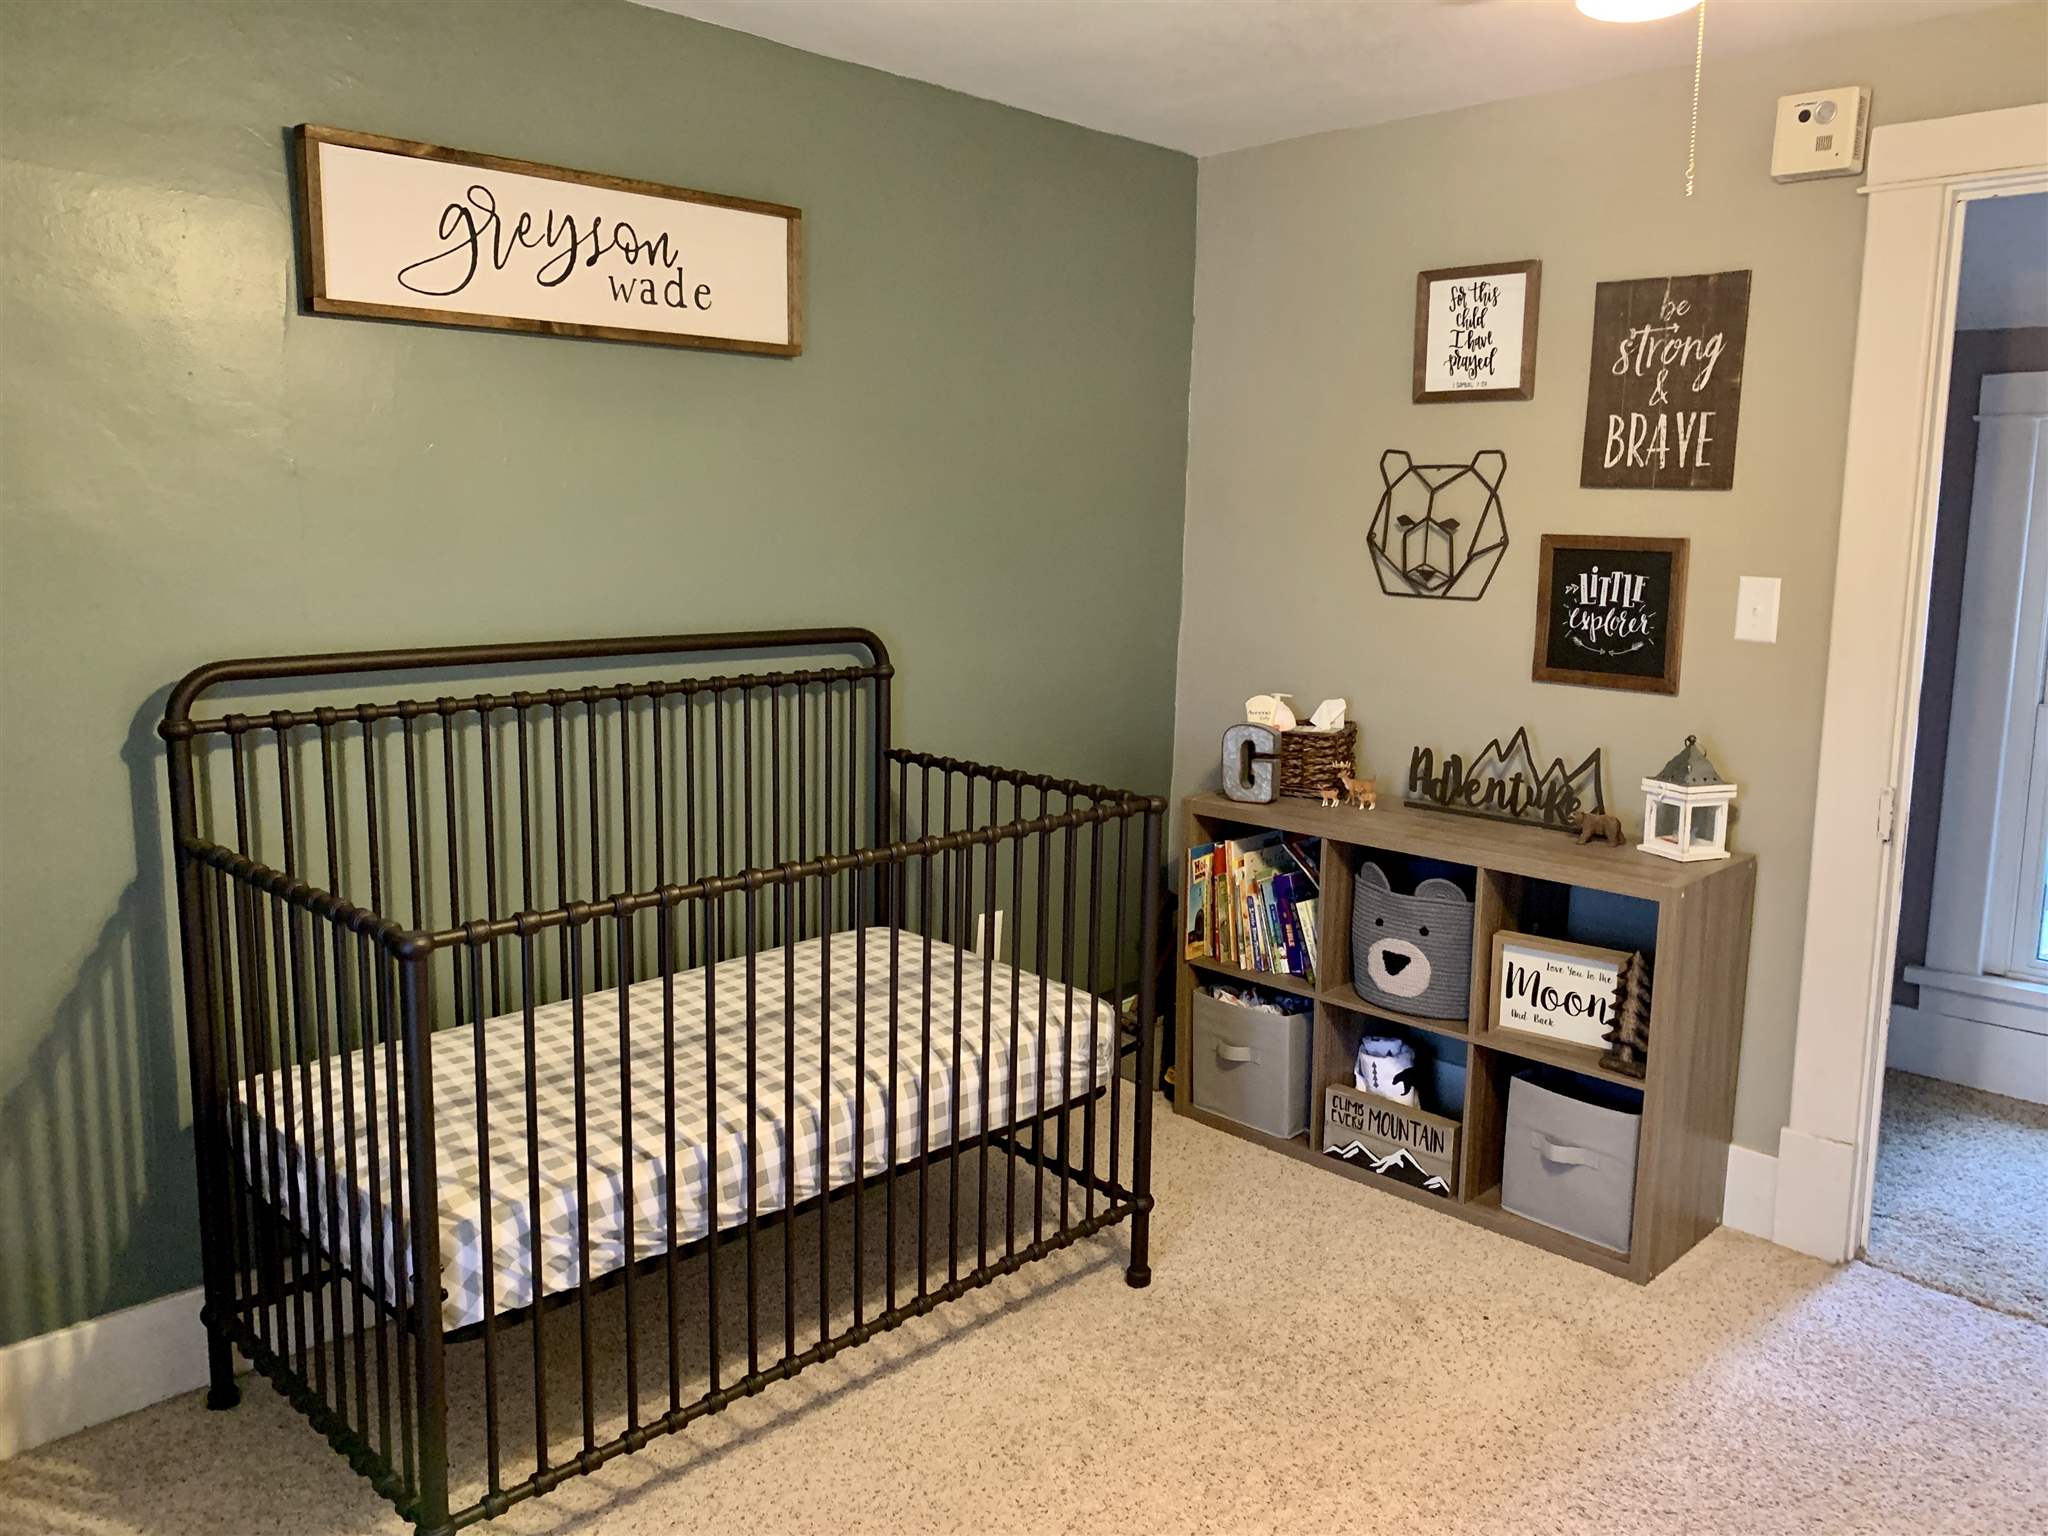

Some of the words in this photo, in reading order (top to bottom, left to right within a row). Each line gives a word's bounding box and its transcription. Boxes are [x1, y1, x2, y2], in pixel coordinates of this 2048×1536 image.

[398, 184, 680, 297] greyson
[608, 266, 713, 311] wade
[1448, 285, 1467, 312] for
[1468, 281, 1501, 307] this
[1660, 289, 1691, 321] be
[1456, 306, 1489, 330] child
[1448, 329, 1465, 349] I
[1465, 330, 1494, 352] have
[1612, 324, 1727, 393] strong
[1443, 347, 1498, 380] prayed
[1648, 367, 1669, 406] &
[1603, 411, 1717, 469] BRAVE
[1569, 607, 1650, 643] explorer
[1505, 961, 1608, 1025] Moon
[1332, 1095, 1364, 1117] CLIMB
[1331, 1108, 1364, 1130] EVERY
[1367, 1108, 1445, 1154] MOUNTAIN
